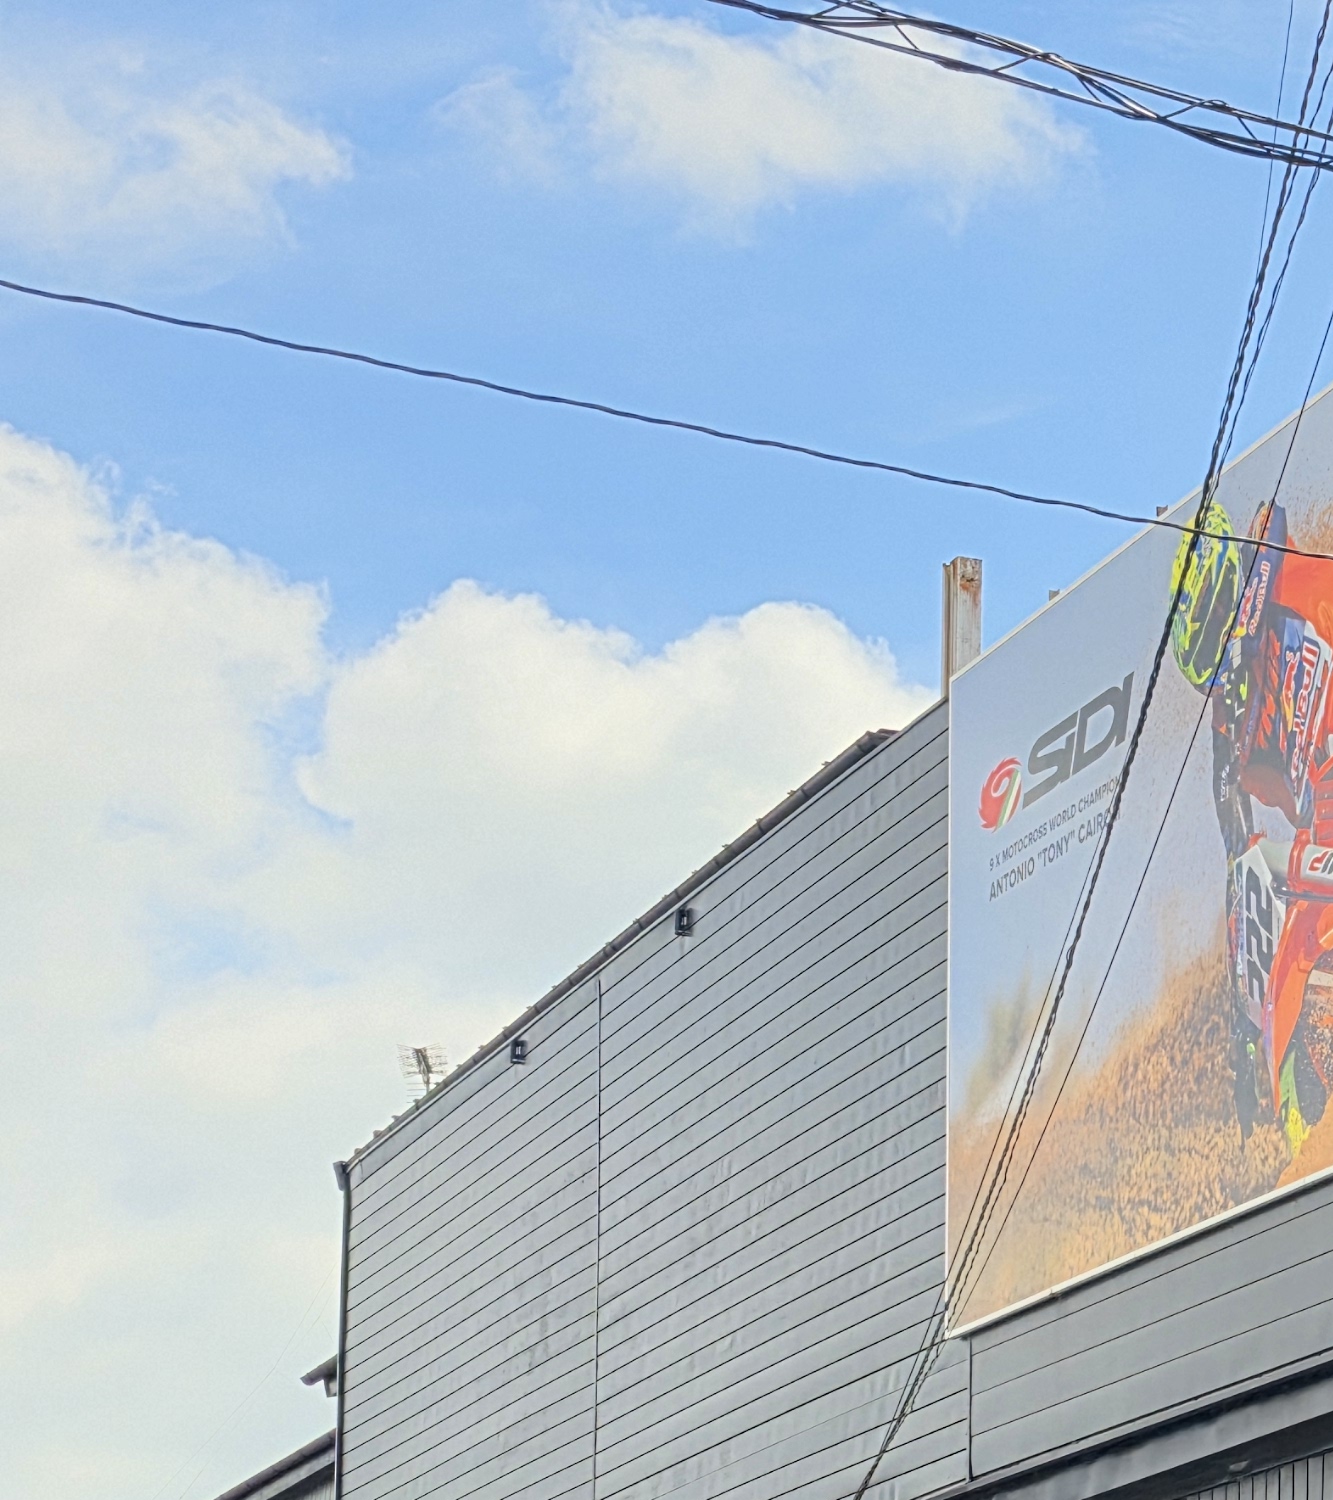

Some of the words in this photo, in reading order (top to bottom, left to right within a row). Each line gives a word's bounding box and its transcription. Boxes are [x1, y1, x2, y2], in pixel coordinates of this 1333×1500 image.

[1002, 821, 1048, 863] MOTOCROSS
[1049, 806, 1077, 832] WORLD
[989, 856, 1035, 902] ANTONIO
